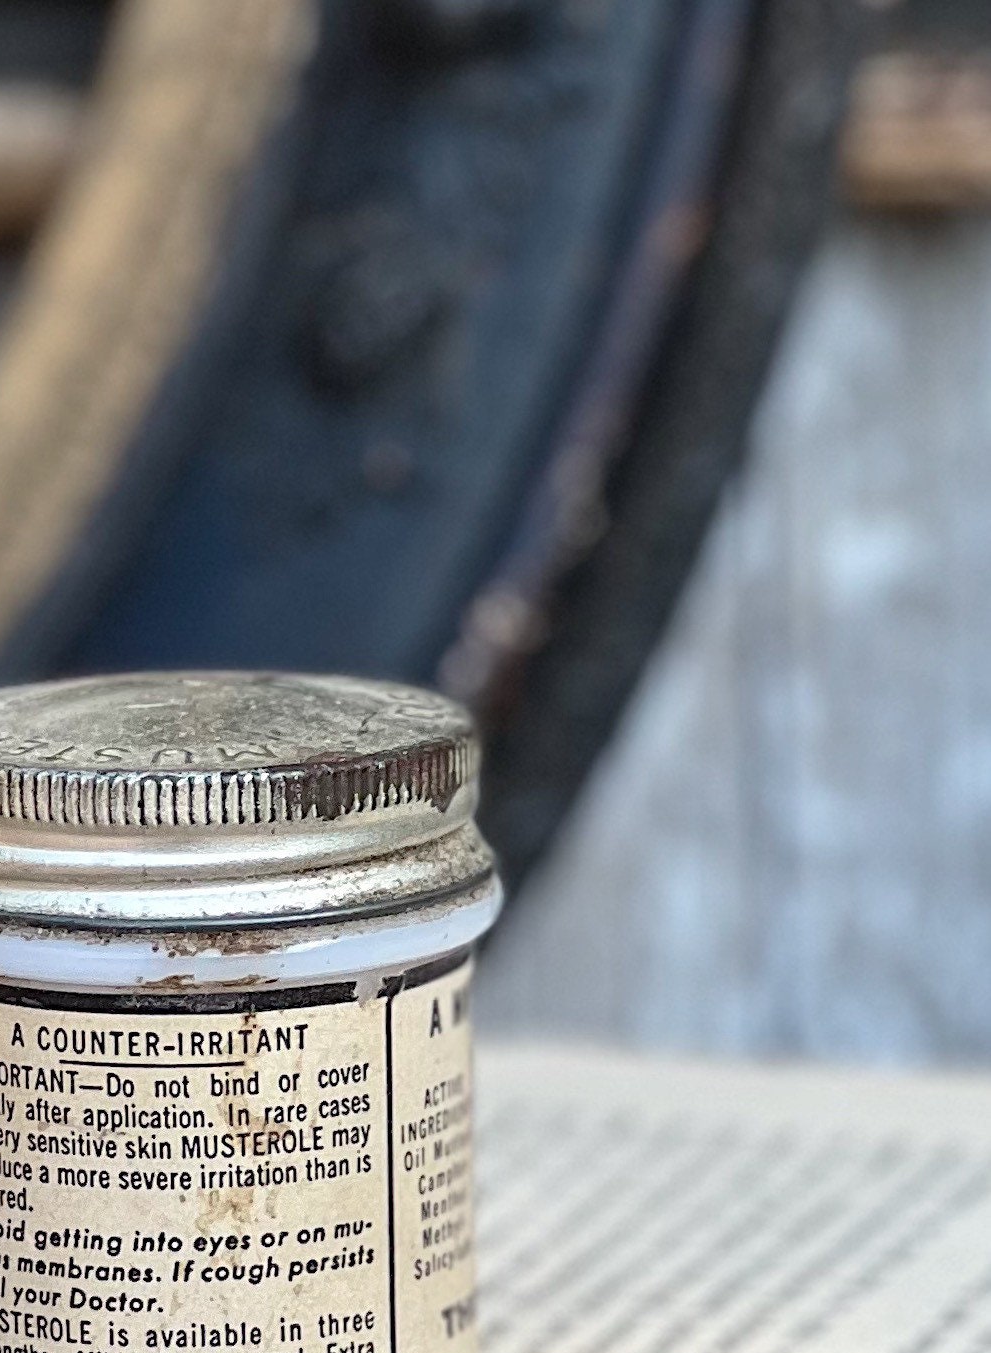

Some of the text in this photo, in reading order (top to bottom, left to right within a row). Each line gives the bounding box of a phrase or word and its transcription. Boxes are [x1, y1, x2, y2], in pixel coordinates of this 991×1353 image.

[11, 1023, 308, 1057] A COUNTER-IRRITANT
[154, 1076, 190, 1098] not
[210, 1071, 259, 1097] bind
[278, 1073, 300, 1093] or
[318, 1063, 369, 1088] cover
[26, 1098, 71, 1125] after
[83, 1103, 214, 1132] application.
[228, 1103, 250, 1127] In
[263, 1103, 307, 1124] rare
[318, 1093, 370, 1118] cases
[27, 1130, 117, 1158] sensitive
[125, 1134, 171, 1159] skin
[181, 1128, 324, 1159] MUSTEROLE
[332, 1122, 371, 1148] may
[39, 1165, 49, 1183] a
[58, 1168, 110, 1189] more
[119, 1171, 191, 1191] severe
[200, 1163, 298, 1189] irritation
[306, 1157, 349, 1181] than
[357, 1150, 371, 1173] is
[404, 1148, 426, 1172] Oil
[34, 1229, 123, 1256] getting
[133, 1231, 183, 1252] into
[193, 1234, 251, 1258] eyes
[260, 1231, 289, 1248] or
[297, 1227, 325, 1244] on
[334, 1220, 372, 1239] mu-
[17, 1257, 161, 1283] membranes.
[173, 1260, 195, 1282] If
[201, 1262, 279, 1286] cough
[288, 1245, 374, 1282] persists
[13, 1287, 62, 1307] your
[70, 1287, 164, 1314] Doctor.
[109, 1321, 129, 1347] is
[146, 1322, 262, 1348] available
[280, 1319, 301, 1342] in
[318, 1310, 375, 1338] three
